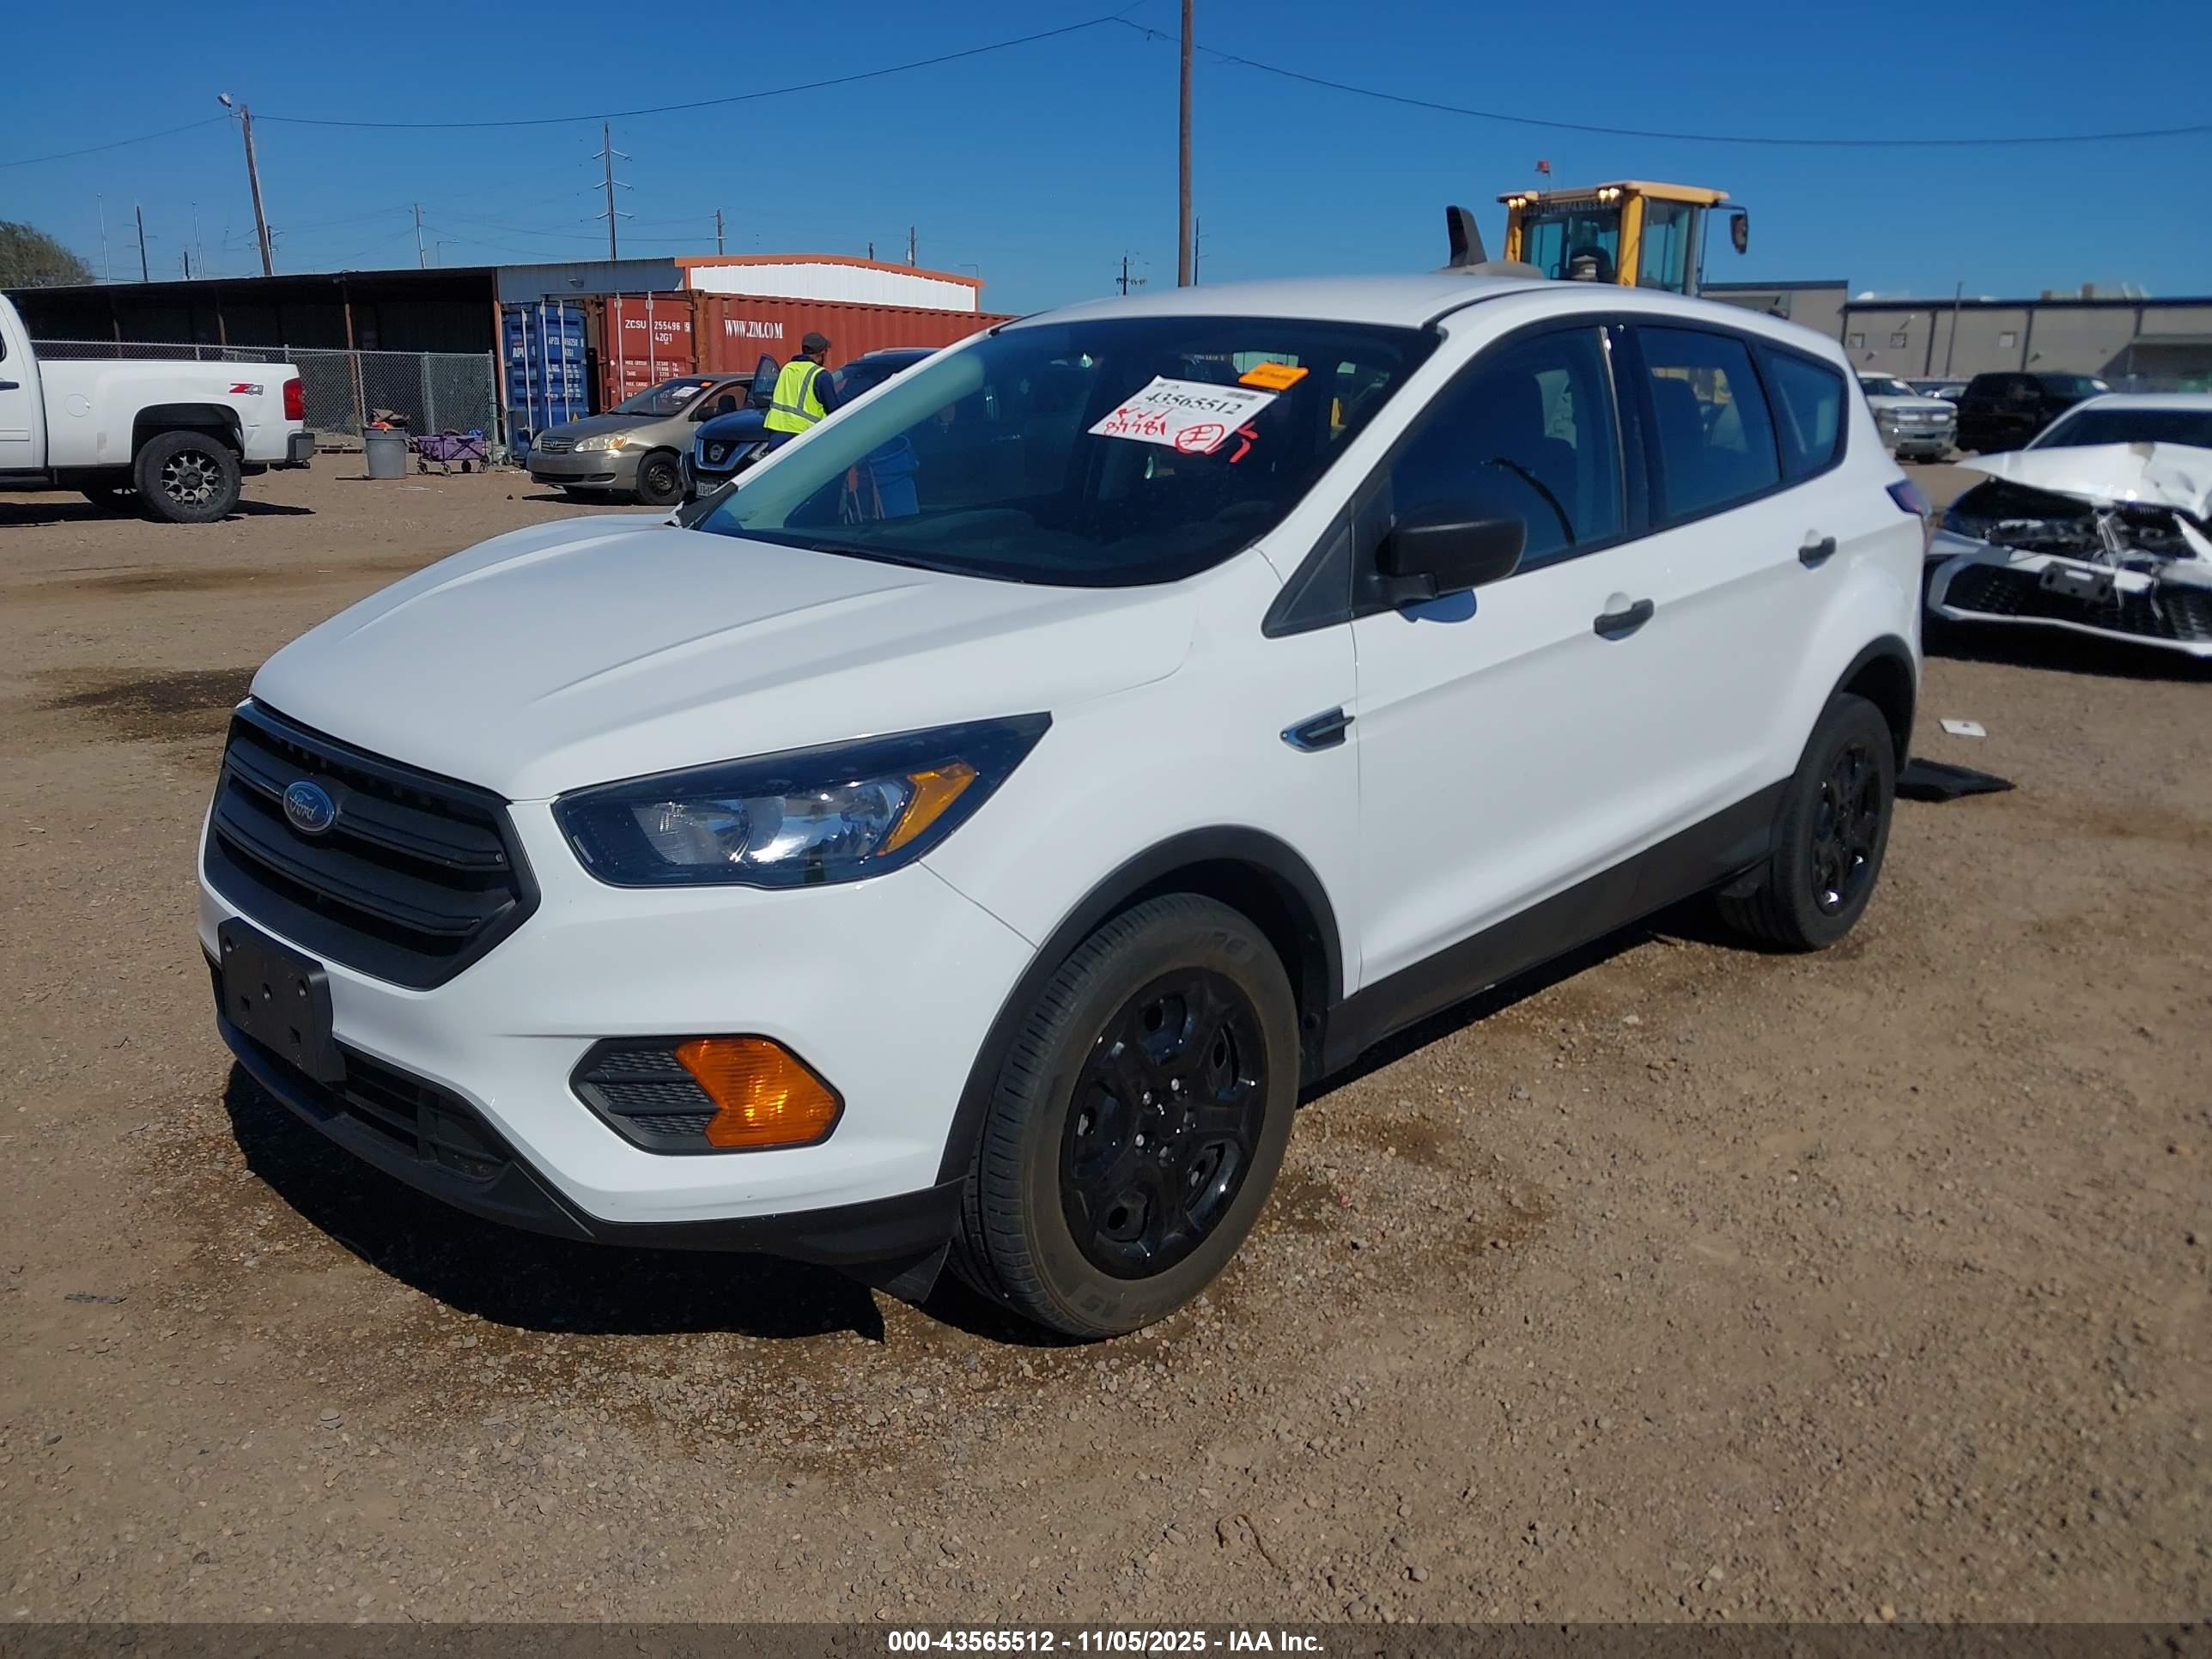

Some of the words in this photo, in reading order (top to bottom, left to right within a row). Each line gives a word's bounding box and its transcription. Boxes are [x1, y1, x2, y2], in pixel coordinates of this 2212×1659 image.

[625, 319, 647, 329] ZCSU
[653, 320, 681, 331] 255496
[654, 333, 672, 342] 42G1
[1145, 392, 1243, 415] 43565512
[289, 789, 319, 822] Ford
